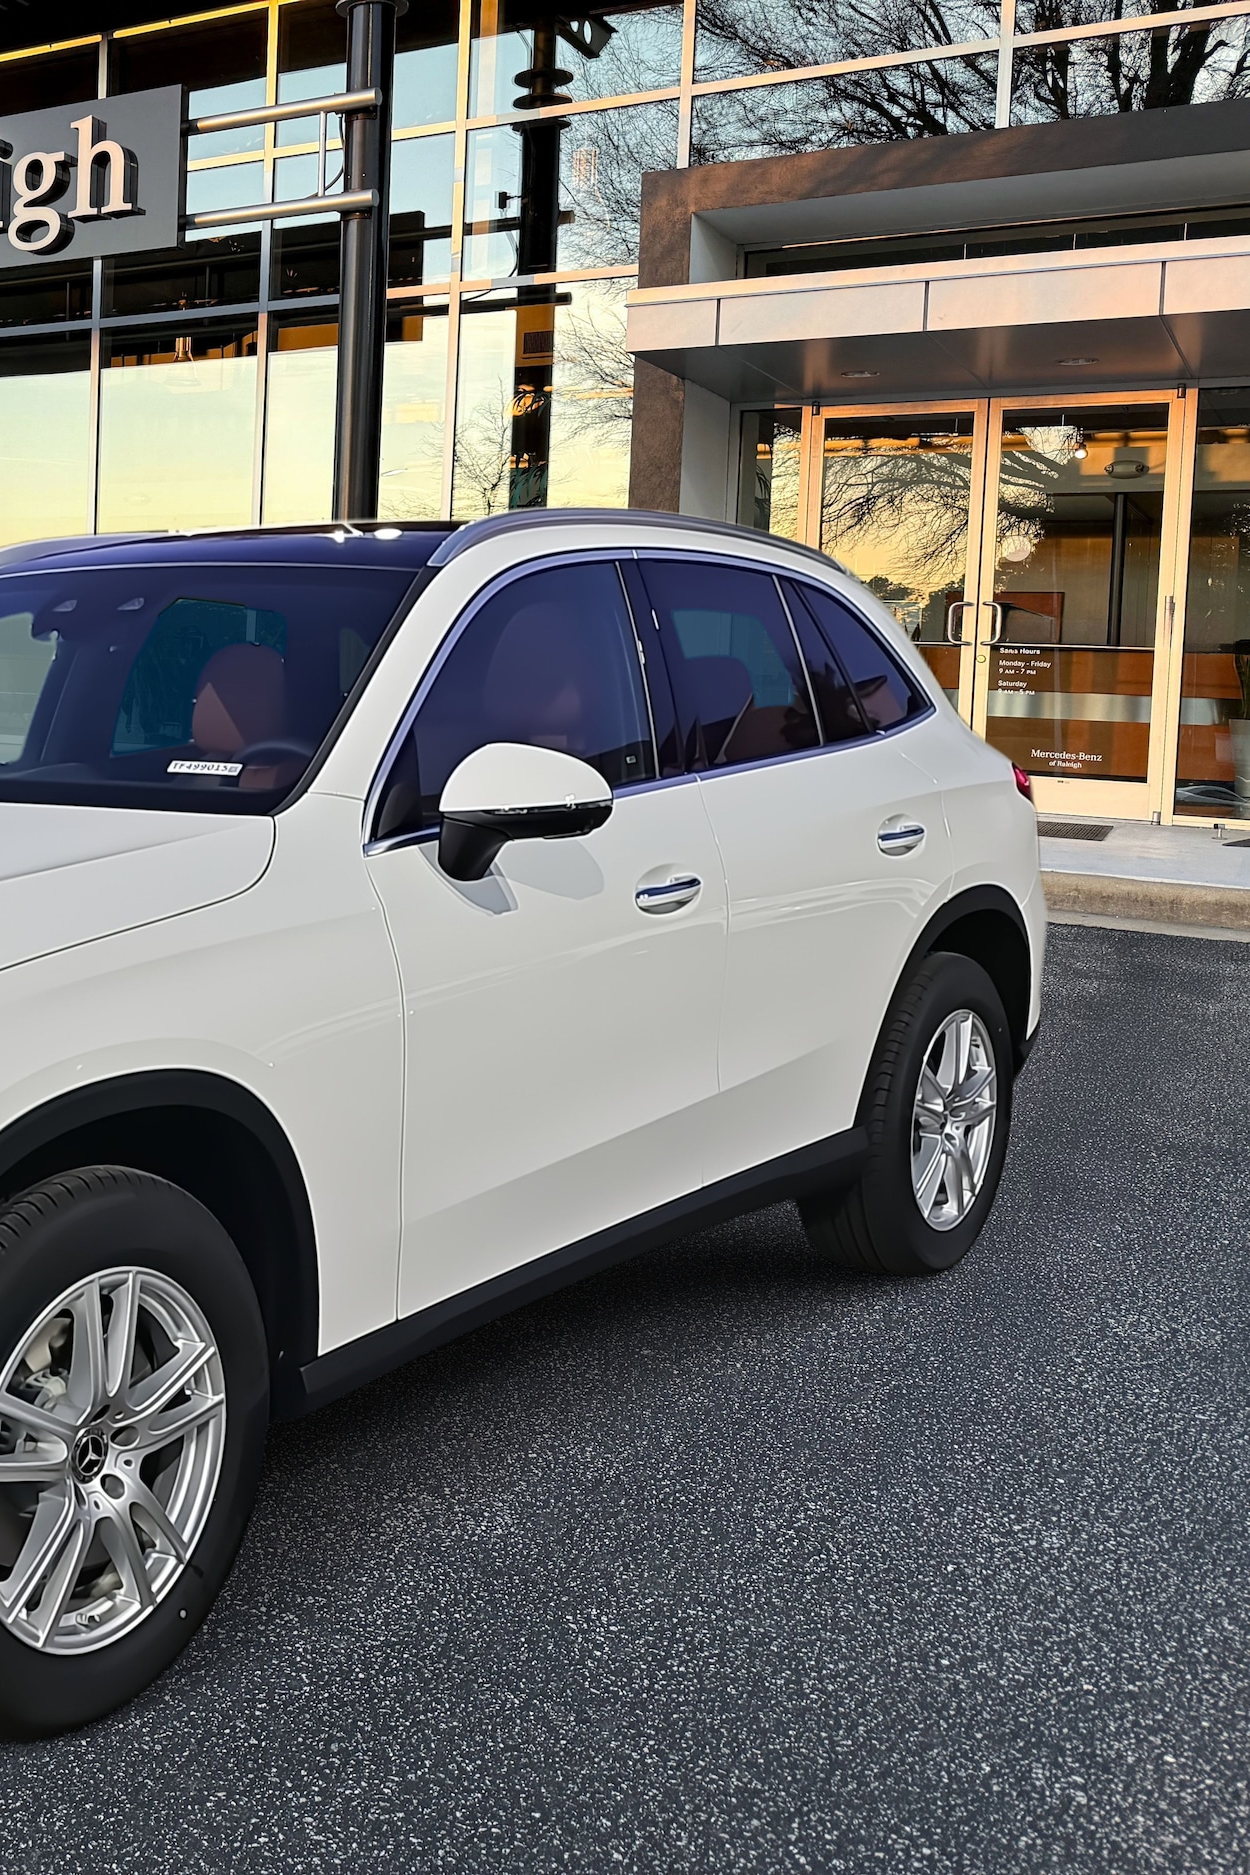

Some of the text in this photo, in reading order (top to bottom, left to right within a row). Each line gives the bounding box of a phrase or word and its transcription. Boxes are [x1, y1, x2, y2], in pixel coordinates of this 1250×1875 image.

[1031, 660, 1051, 668] Friday
[998, 680, 1027, 688] Saturday
[1031, 749, 1102, 761] Mercedes-Benz
[1057, 760, 1082, 769] Raleigh
